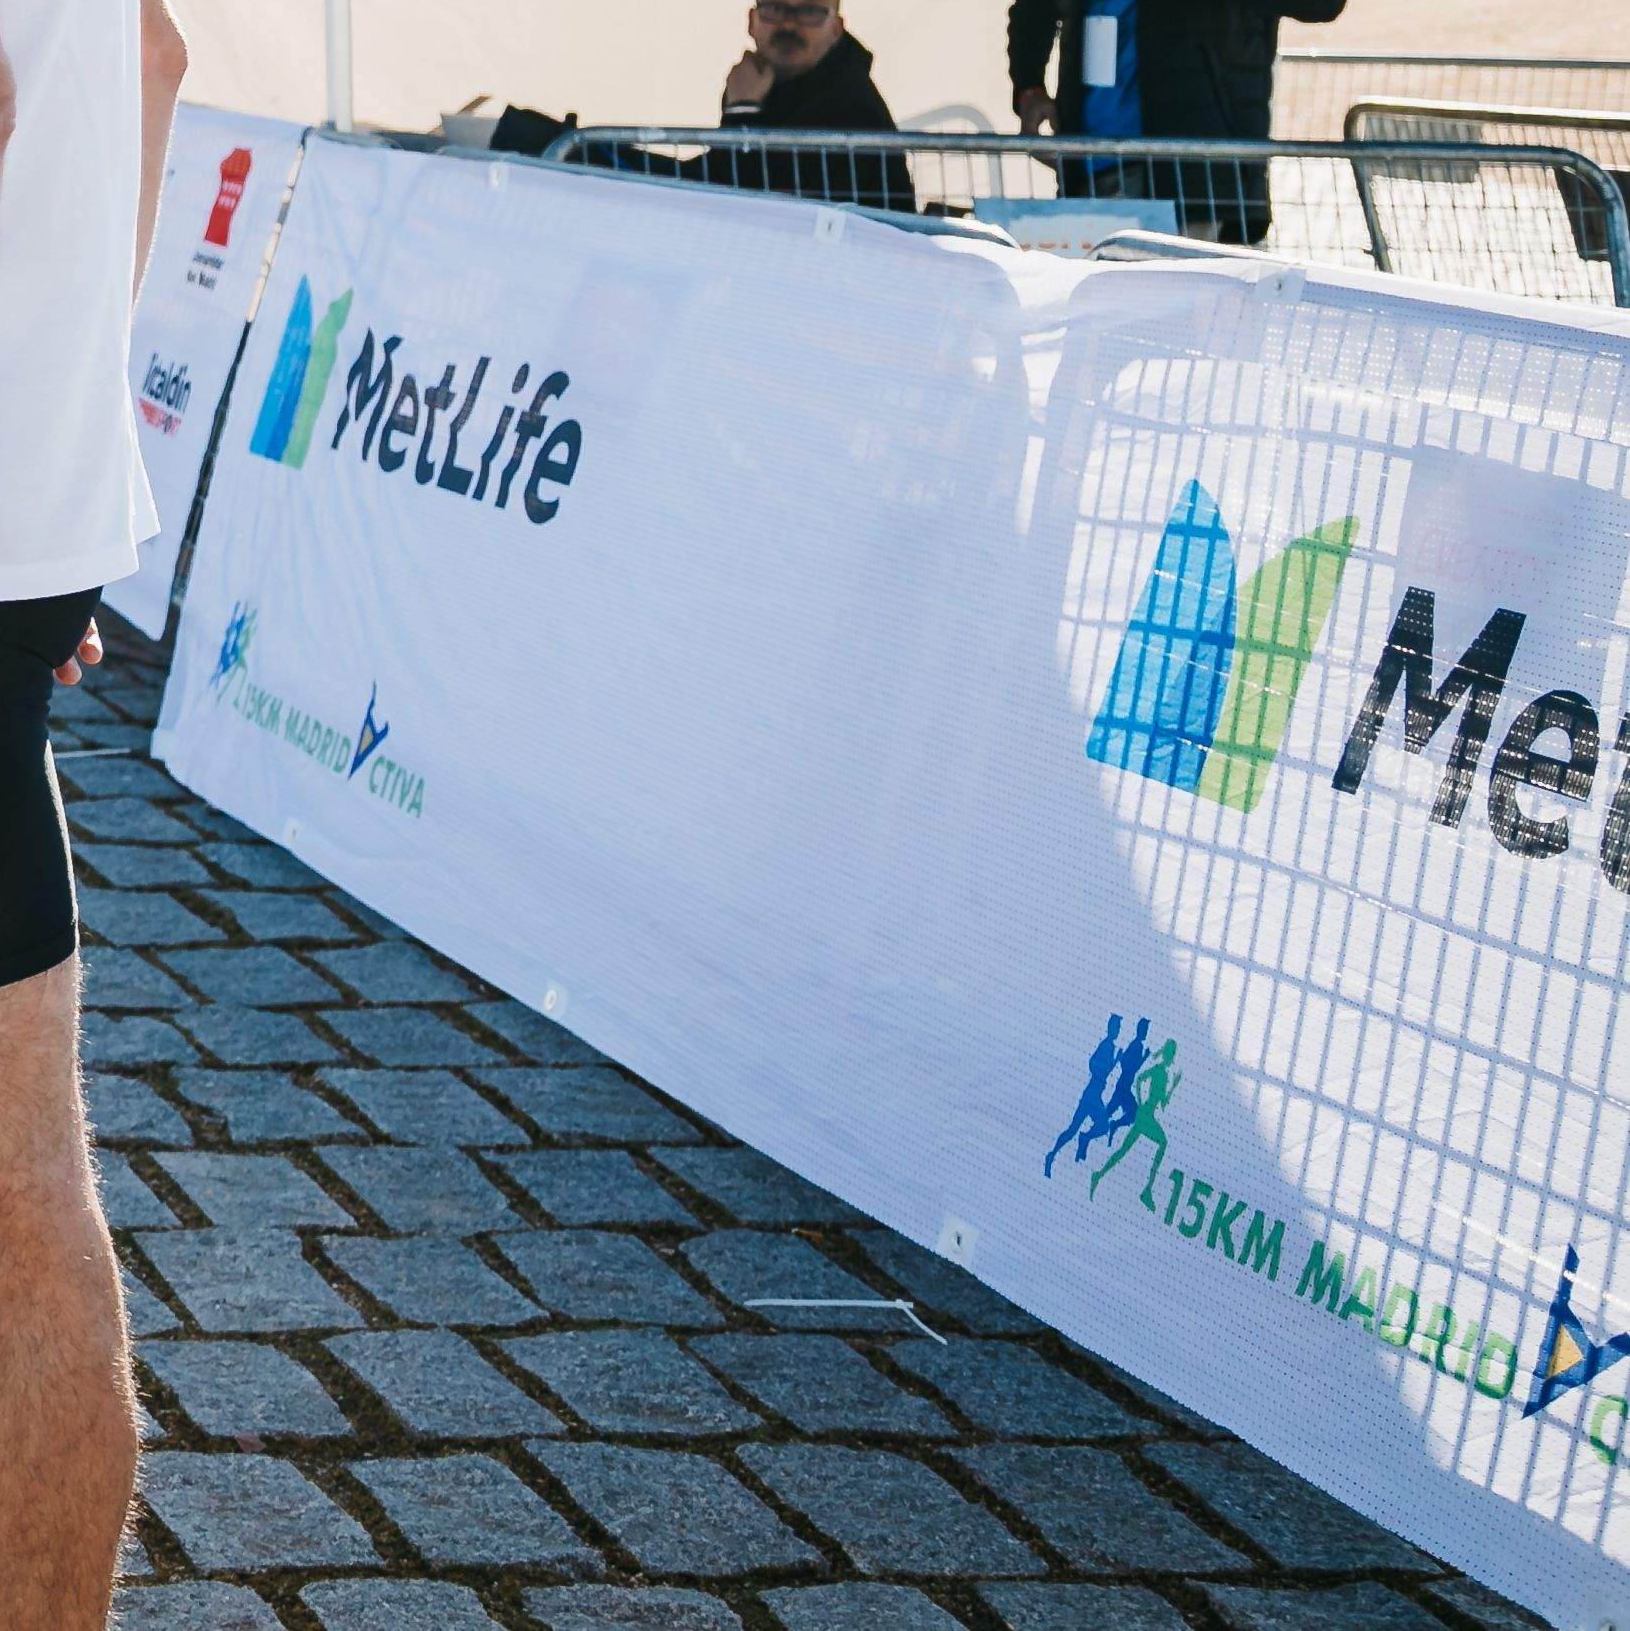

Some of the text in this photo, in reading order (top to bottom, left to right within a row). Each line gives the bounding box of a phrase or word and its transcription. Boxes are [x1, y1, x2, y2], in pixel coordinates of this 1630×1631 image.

[331, 327, 584, 525] MetLife
[284, 705, 352, 775] MADRID
[1163, 1169, 1287, 1282] 15KM
[1295, 1239, 1518, 1400] MADRID
